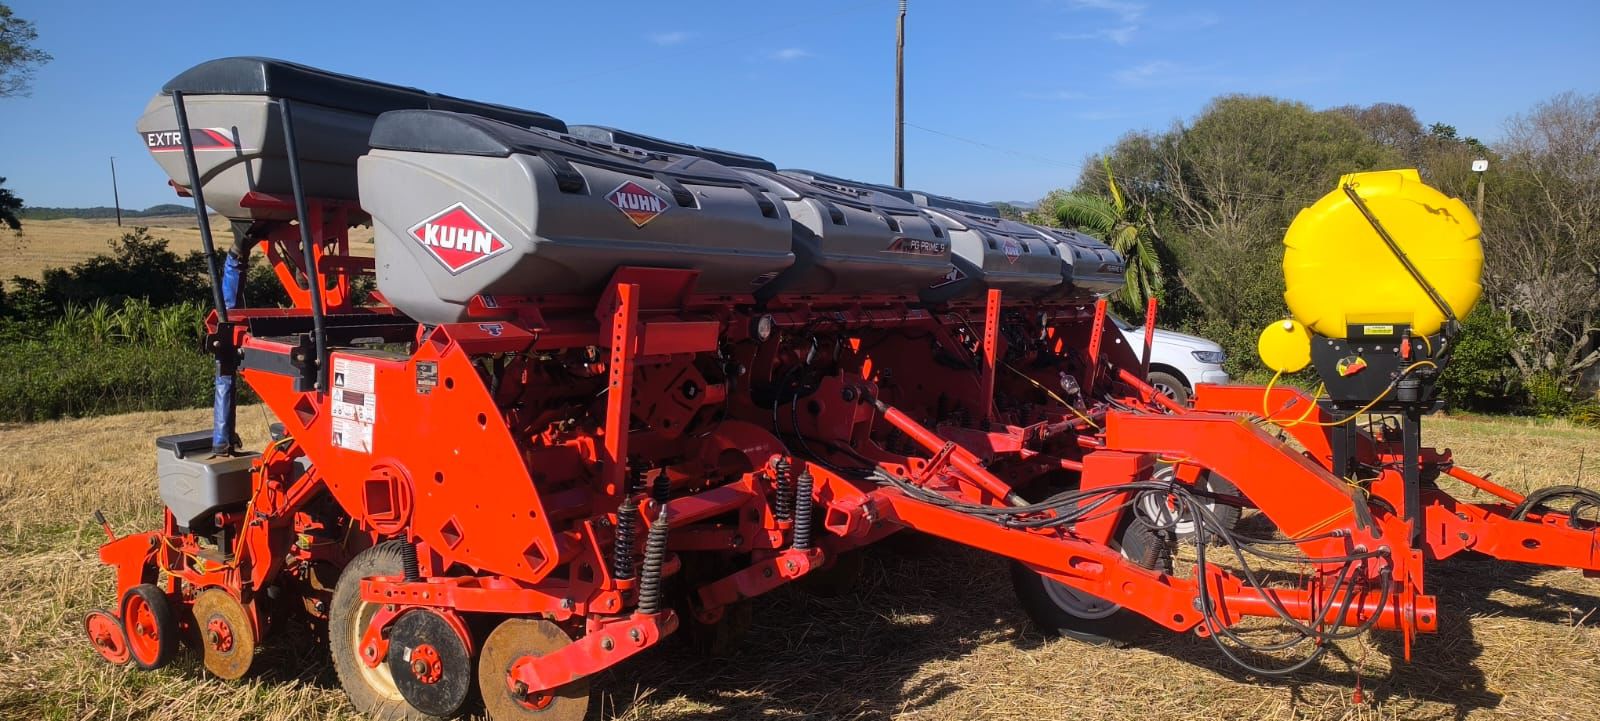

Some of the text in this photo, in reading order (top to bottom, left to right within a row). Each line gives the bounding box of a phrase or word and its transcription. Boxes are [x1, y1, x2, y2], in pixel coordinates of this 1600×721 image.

[148, 132, 182, 146] EXTR
[615, 191, 661, 212] KUHN
[424, 223, 492, 255] KUHN
[910, 239, 920, 250] PG
[920, 241, 939, 252] PRIME
